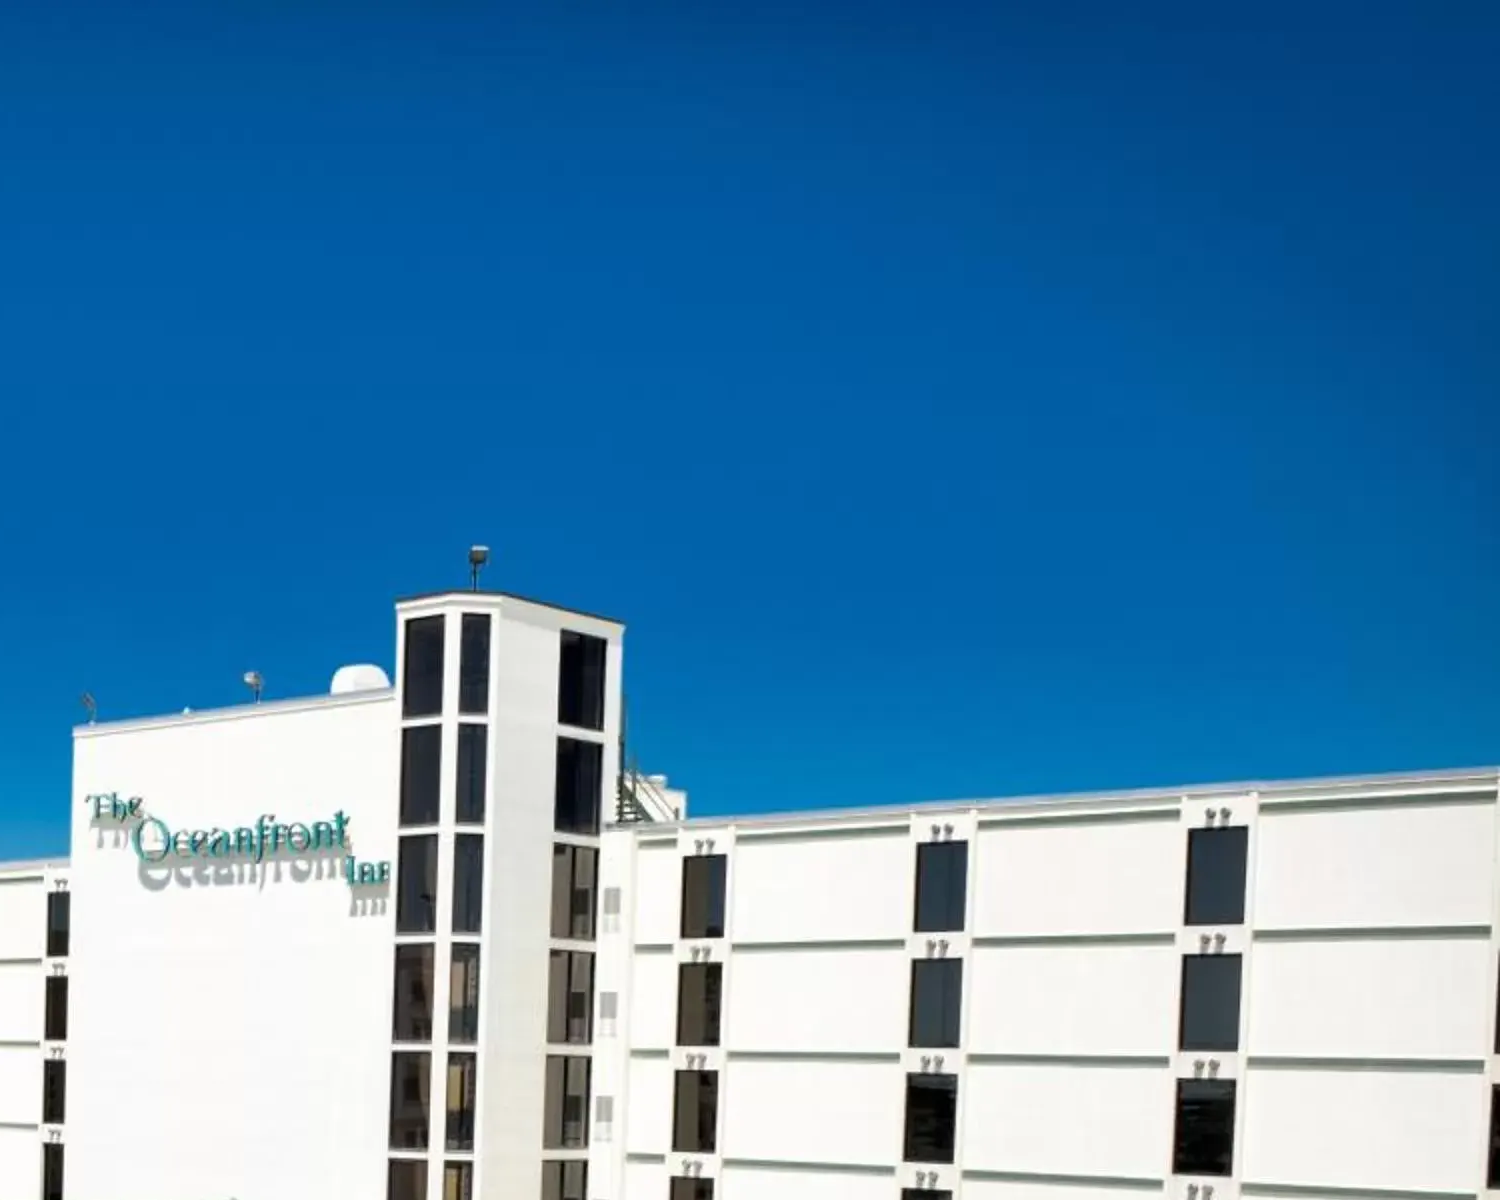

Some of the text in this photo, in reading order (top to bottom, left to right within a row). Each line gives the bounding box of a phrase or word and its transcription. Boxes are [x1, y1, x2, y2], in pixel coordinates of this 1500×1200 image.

[84, 792, 143, 821] The
[132, 811, 351, 864] Oceanfront
[346, 856, 391, 886] Inn
